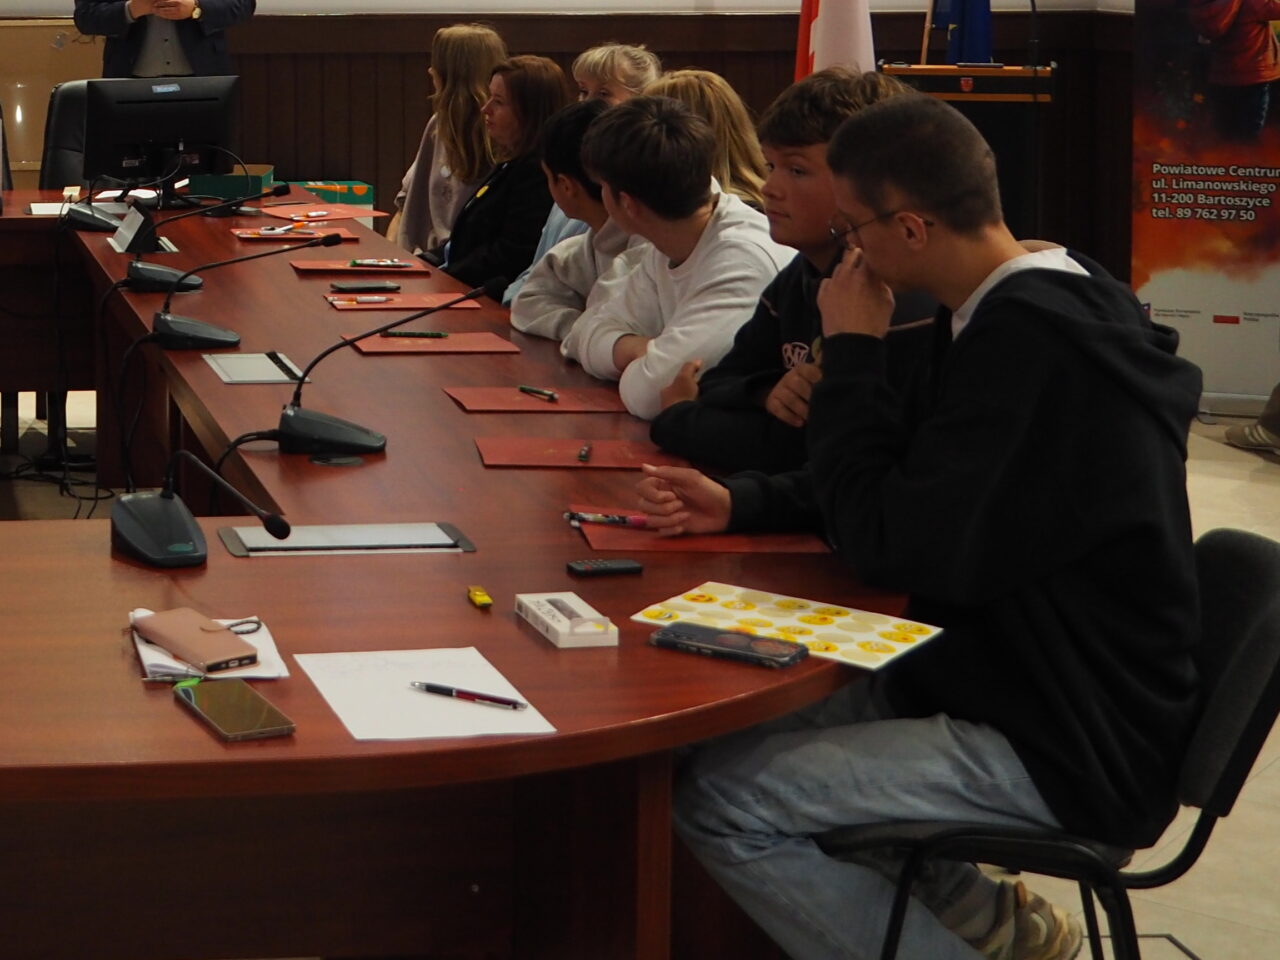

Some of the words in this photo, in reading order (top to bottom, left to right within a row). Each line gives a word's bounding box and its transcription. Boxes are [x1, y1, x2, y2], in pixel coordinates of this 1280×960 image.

[1153, 164, 1225, 175] Powiatowe
[1153, 179, 1168, 188] ul.
[1172, 178, 1276, 194] Limanowskiego
[1154, 193, 1193, 203] 11-200
[1197, 193, 1271, 208] Bartoszyce
[1152, 208, 1172, 217] tel.
[1177, 208, 1191, 217] 89
[1195, 209, 1217, 218] 762
[1221, 210, 1236, 219] 97
[1240, 211, 1254, 220] 50
